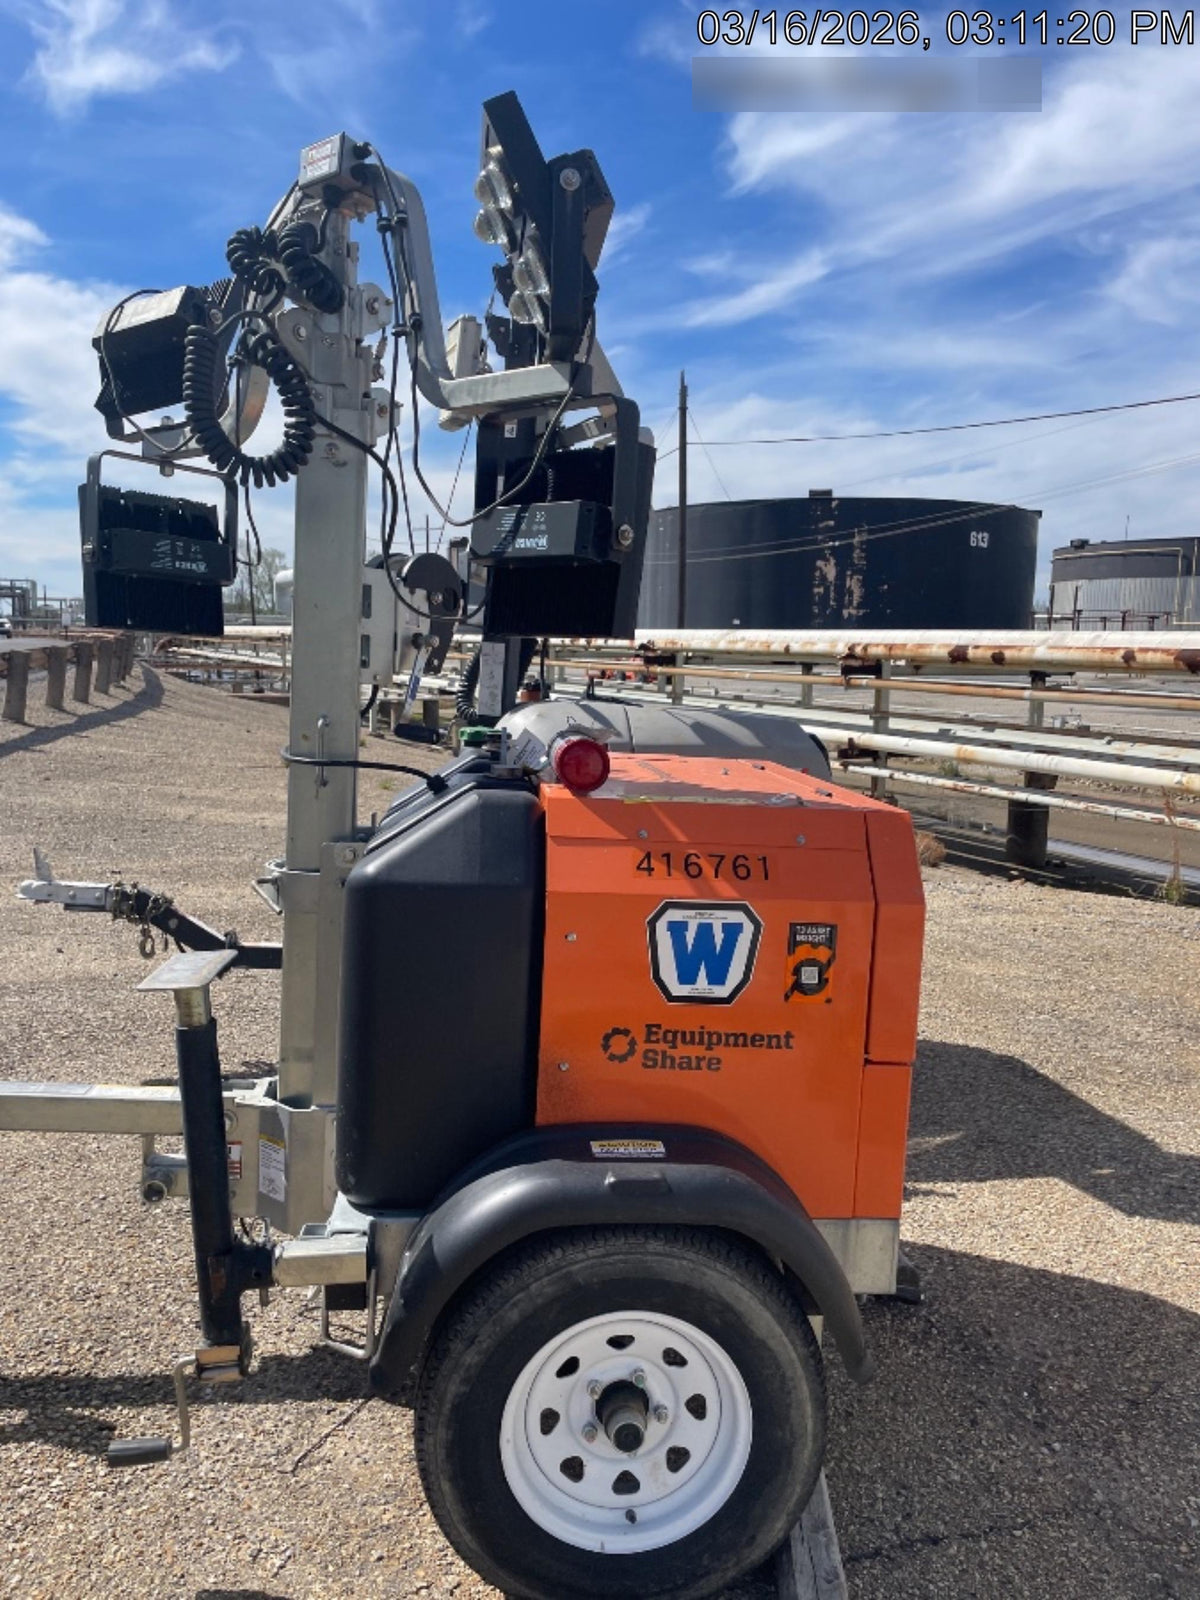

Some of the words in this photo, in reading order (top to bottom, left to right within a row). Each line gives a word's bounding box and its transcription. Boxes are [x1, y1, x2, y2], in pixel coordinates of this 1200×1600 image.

[969, 531, 990, 548] 613
[636, 851, 769, 881] 416761
[666, 921, 743, 986] W
[643, 1023, 795, 1050] Equipment
[641, 1048, 722, 1071] Share
